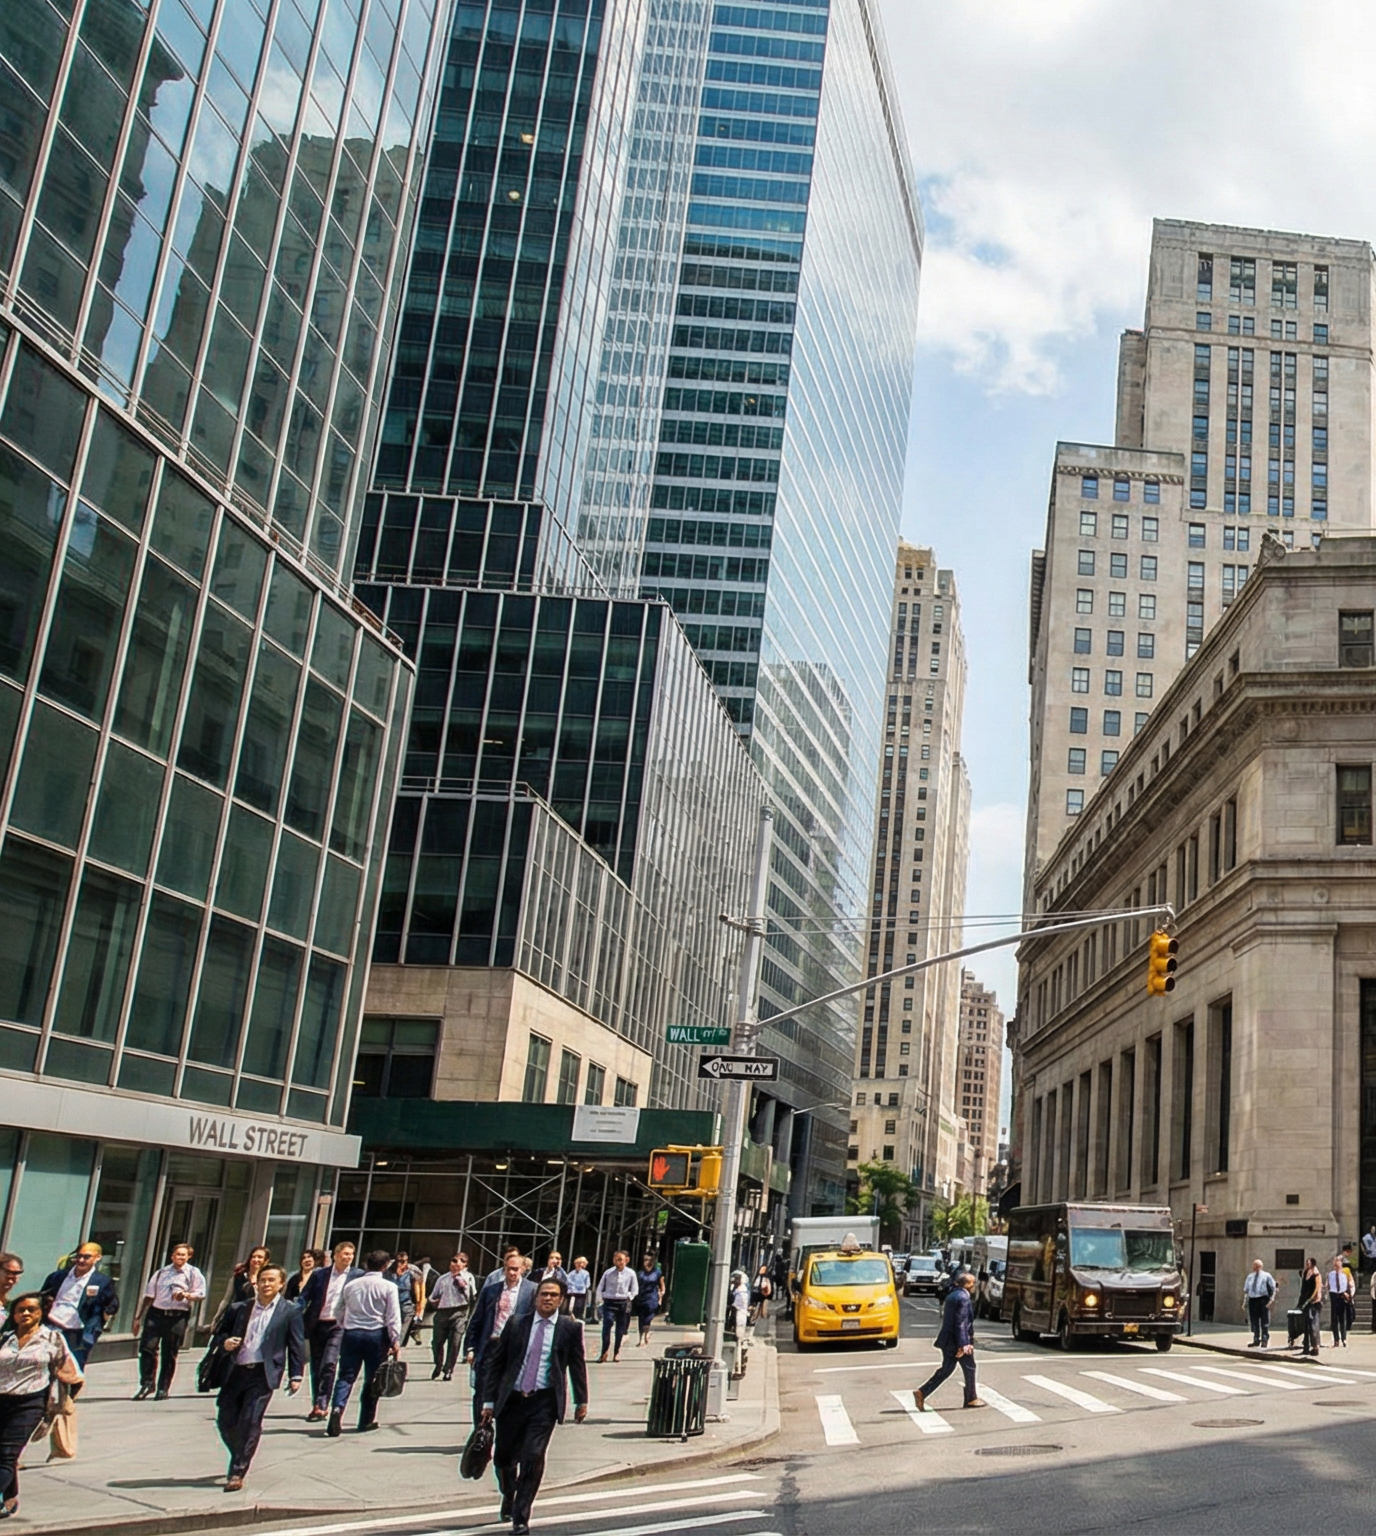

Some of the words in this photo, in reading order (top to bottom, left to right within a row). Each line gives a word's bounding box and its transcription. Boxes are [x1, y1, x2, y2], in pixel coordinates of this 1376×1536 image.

[670, 1027, 700, 1042] WALL
[189, 1116, 238, 1149] WALL
[243, 1125, 309, 1158] STREET
